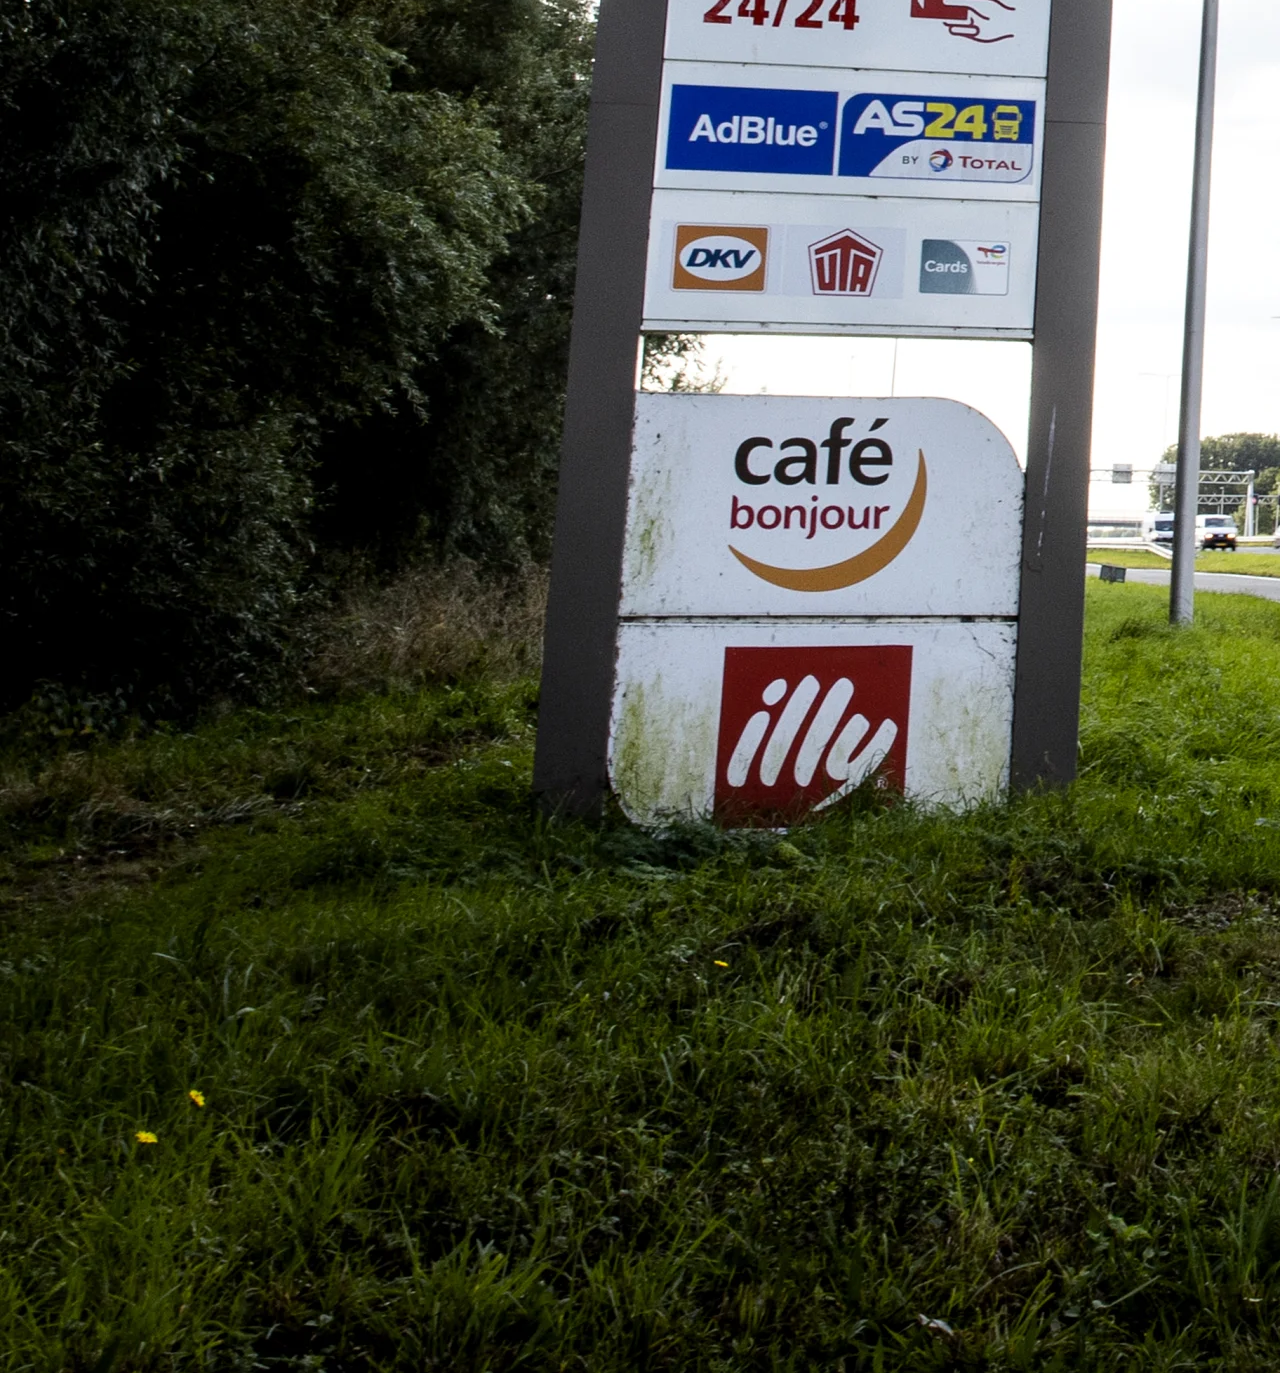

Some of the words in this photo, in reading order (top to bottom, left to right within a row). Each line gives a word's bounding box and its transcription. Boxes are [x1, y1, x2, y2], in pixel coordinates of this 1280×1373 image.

[689, 113, 818, 147] AdBlue
[901, 155, 919, 165] BY
[958, 155, 1022, 172] TOTAL
[686, 248, 756, 269] DKV
[814, 235, 877, 292] UTA
[924, 260, 968, 273] Cards
[734, 417, 893, 486] café
[729, 495, 891, 539] bonjour
[727, 674, 898, 812] illy
